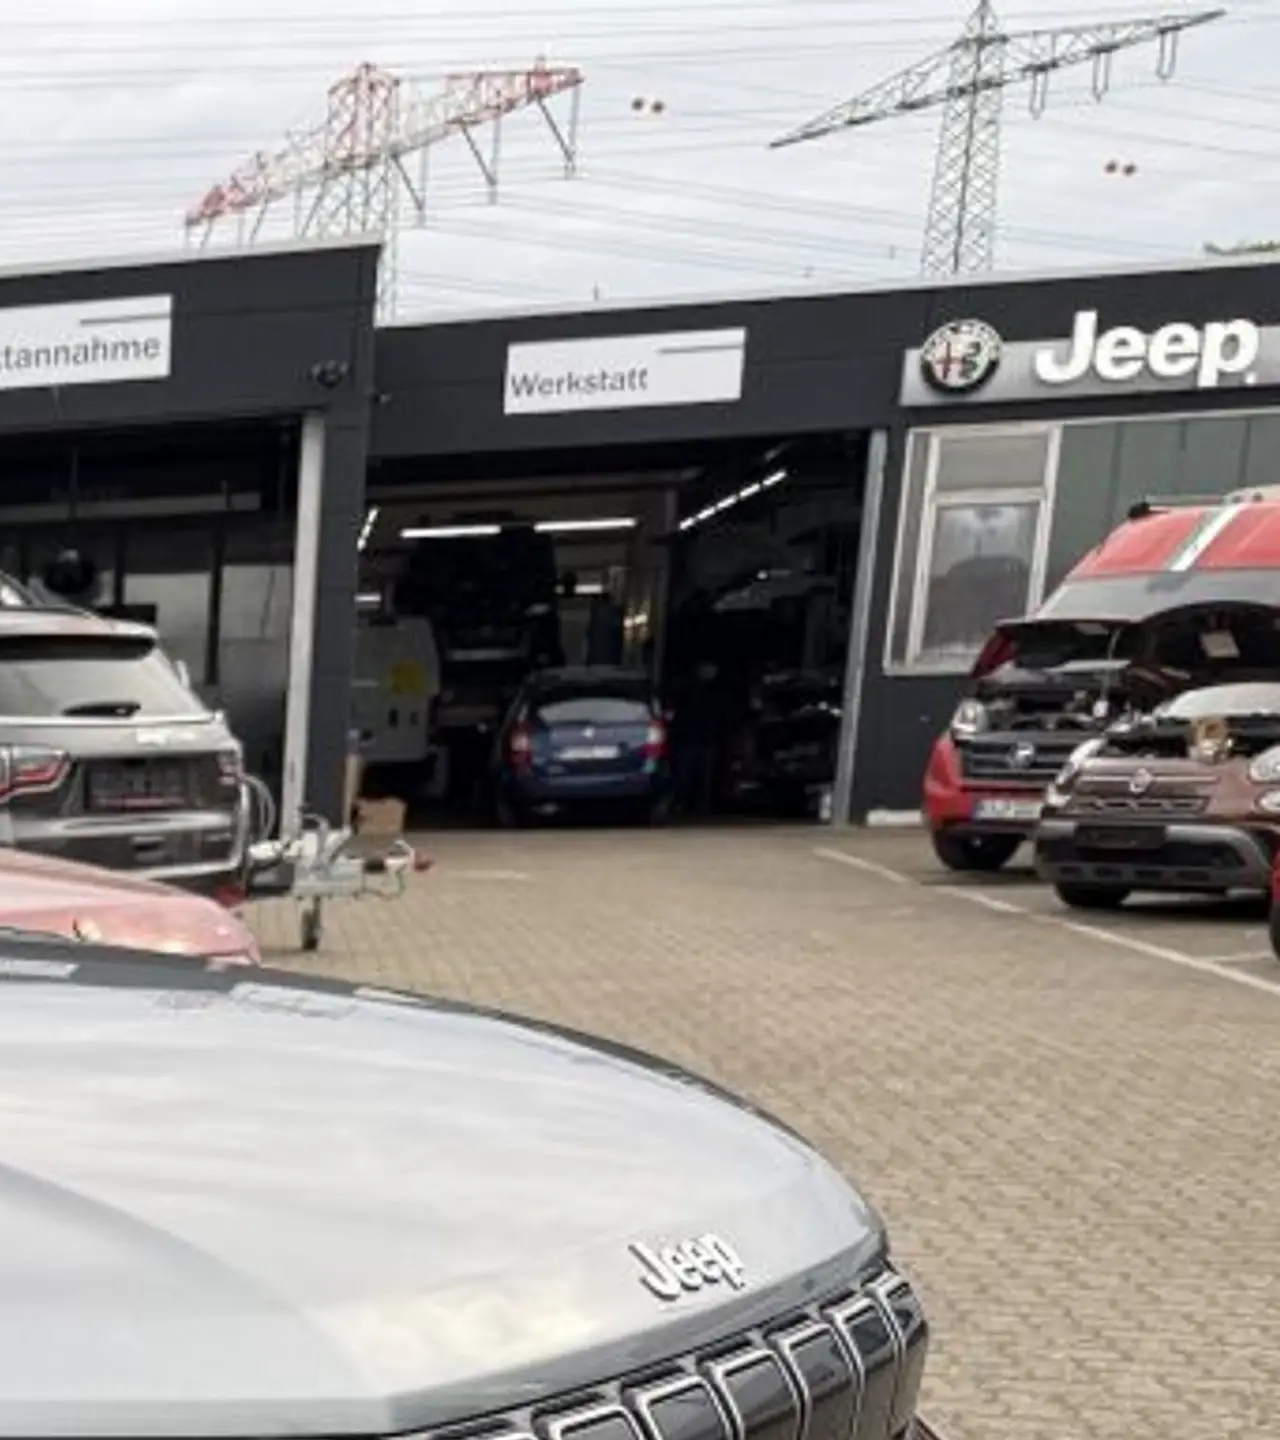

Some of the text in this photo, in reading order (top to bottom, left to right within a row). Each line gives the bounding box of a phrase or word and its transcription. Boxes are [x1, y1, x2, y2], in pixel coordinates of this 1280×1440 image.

[511, 367, 649, 397] Werkstatt
[1035, 309, 1259, 388] Jeep
[626, 1232, 744, 1302] Jeep
